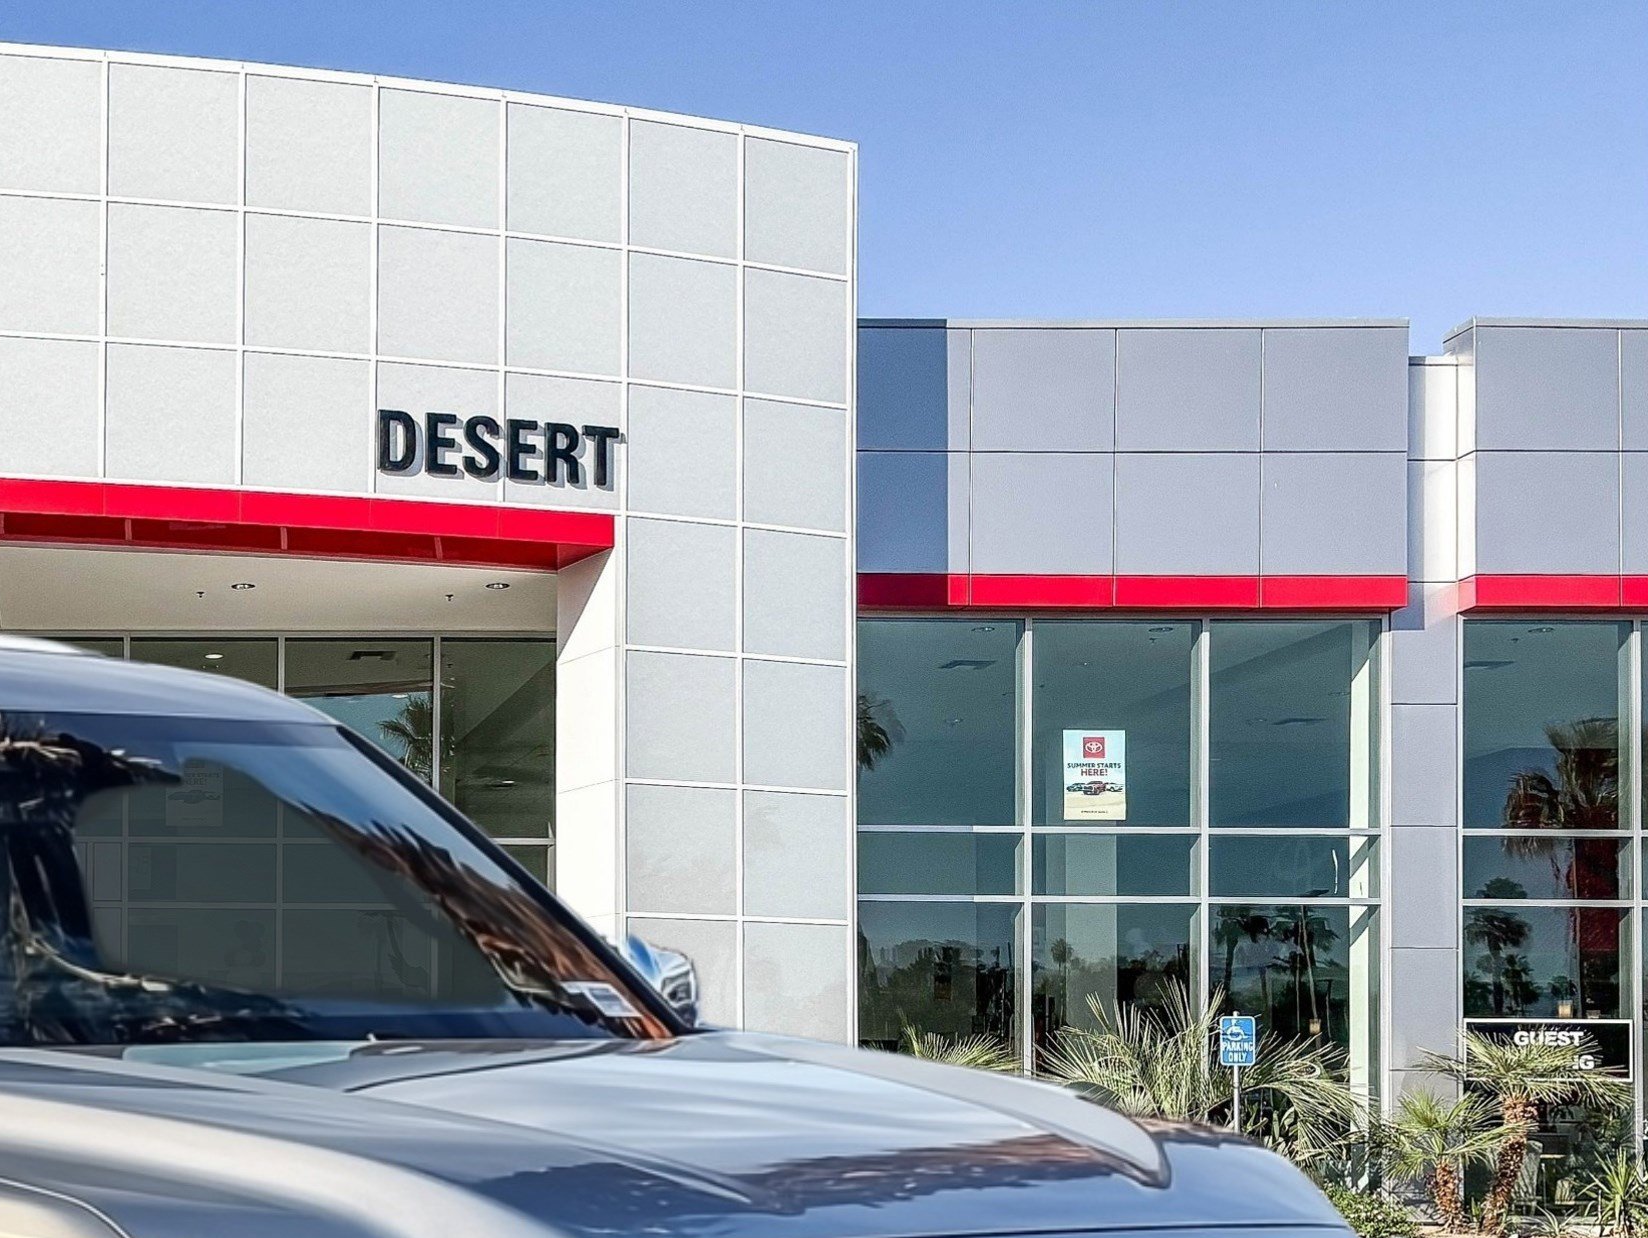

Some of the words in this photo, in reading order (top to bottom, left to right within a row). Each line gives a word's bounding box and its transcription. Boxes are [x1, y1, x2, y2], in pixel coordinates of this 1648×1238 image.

[377, 409, 620, 486] DESERT
[1080, 768, 1108, 776] HERE!
[1513, 1030, 1585, 1047] GUEST
[1222, 1041, 1253, 1052] PARKING
[1228, 1051, 1248, 1063] ONLY
